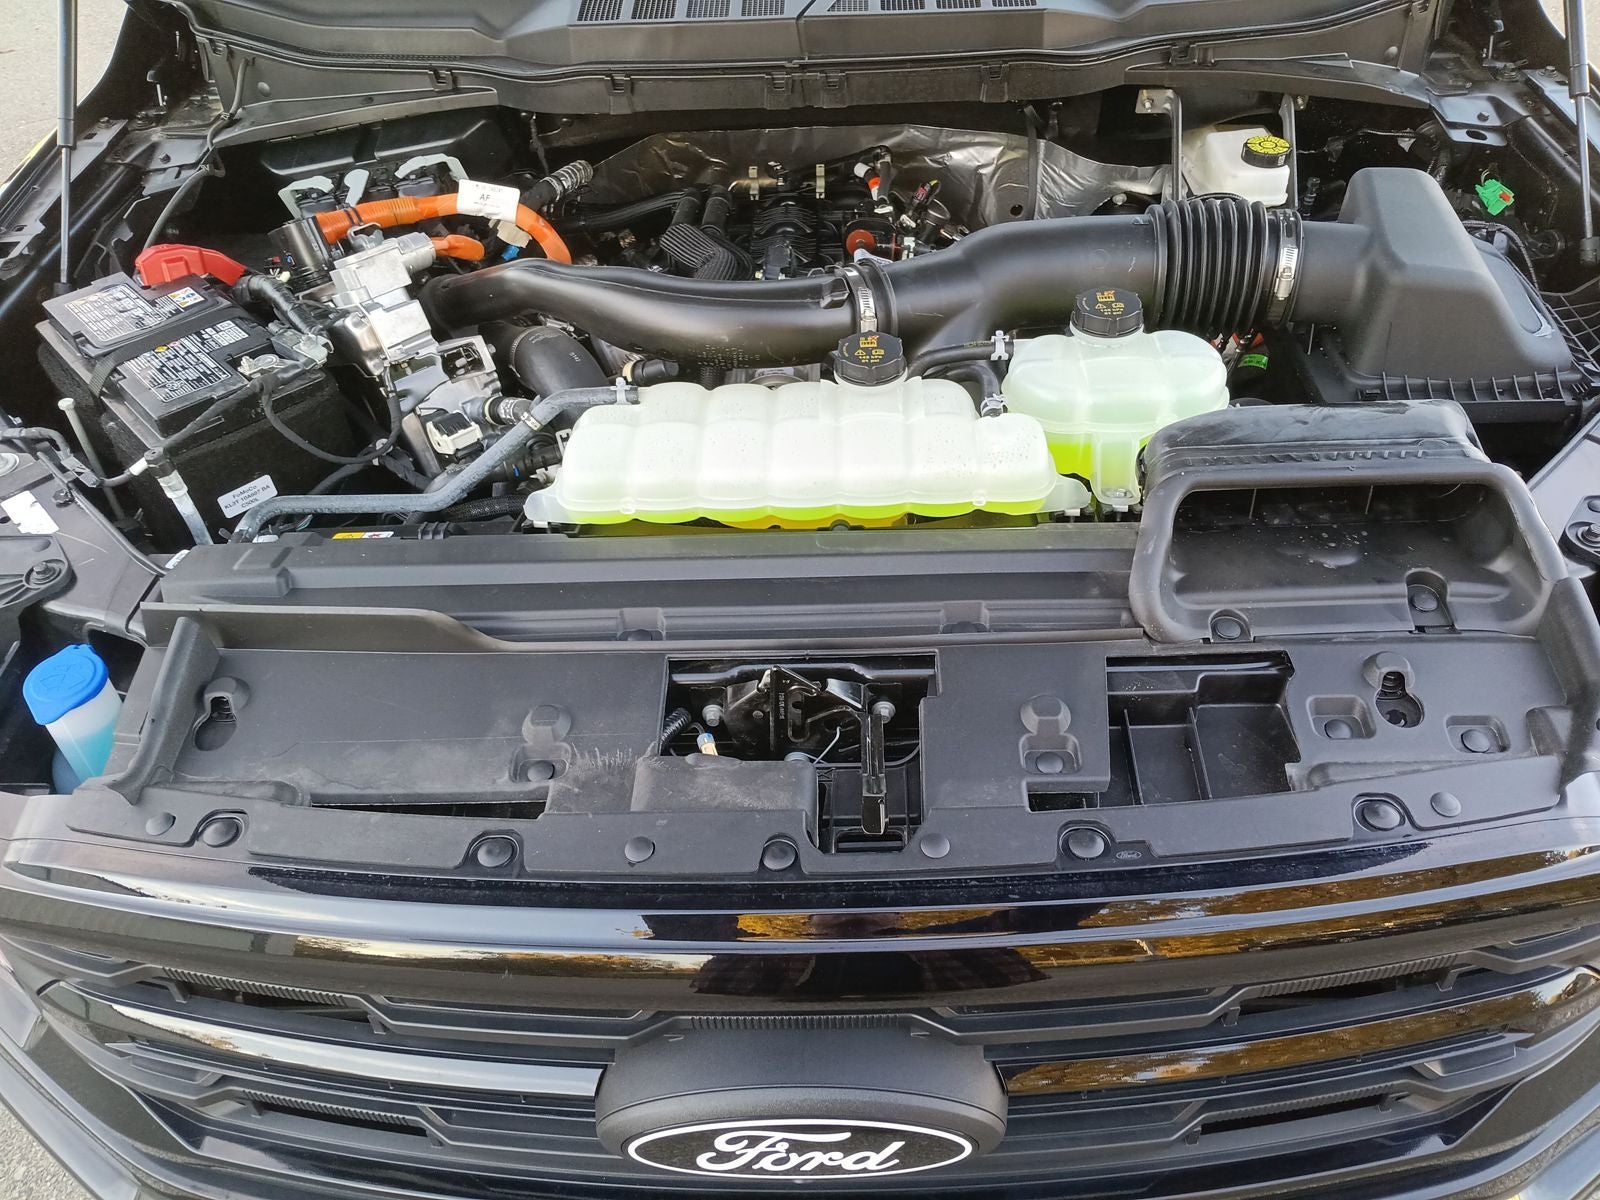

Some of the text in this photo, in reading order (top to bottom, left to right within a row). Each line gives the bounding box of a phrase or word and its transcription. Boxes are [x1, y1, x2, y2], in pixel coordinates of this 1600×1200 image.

[480, 193, 491, 201] AF
[232, 485, 257, 499] FoMoCo
[696, 1130, 906, 1172] Ford
